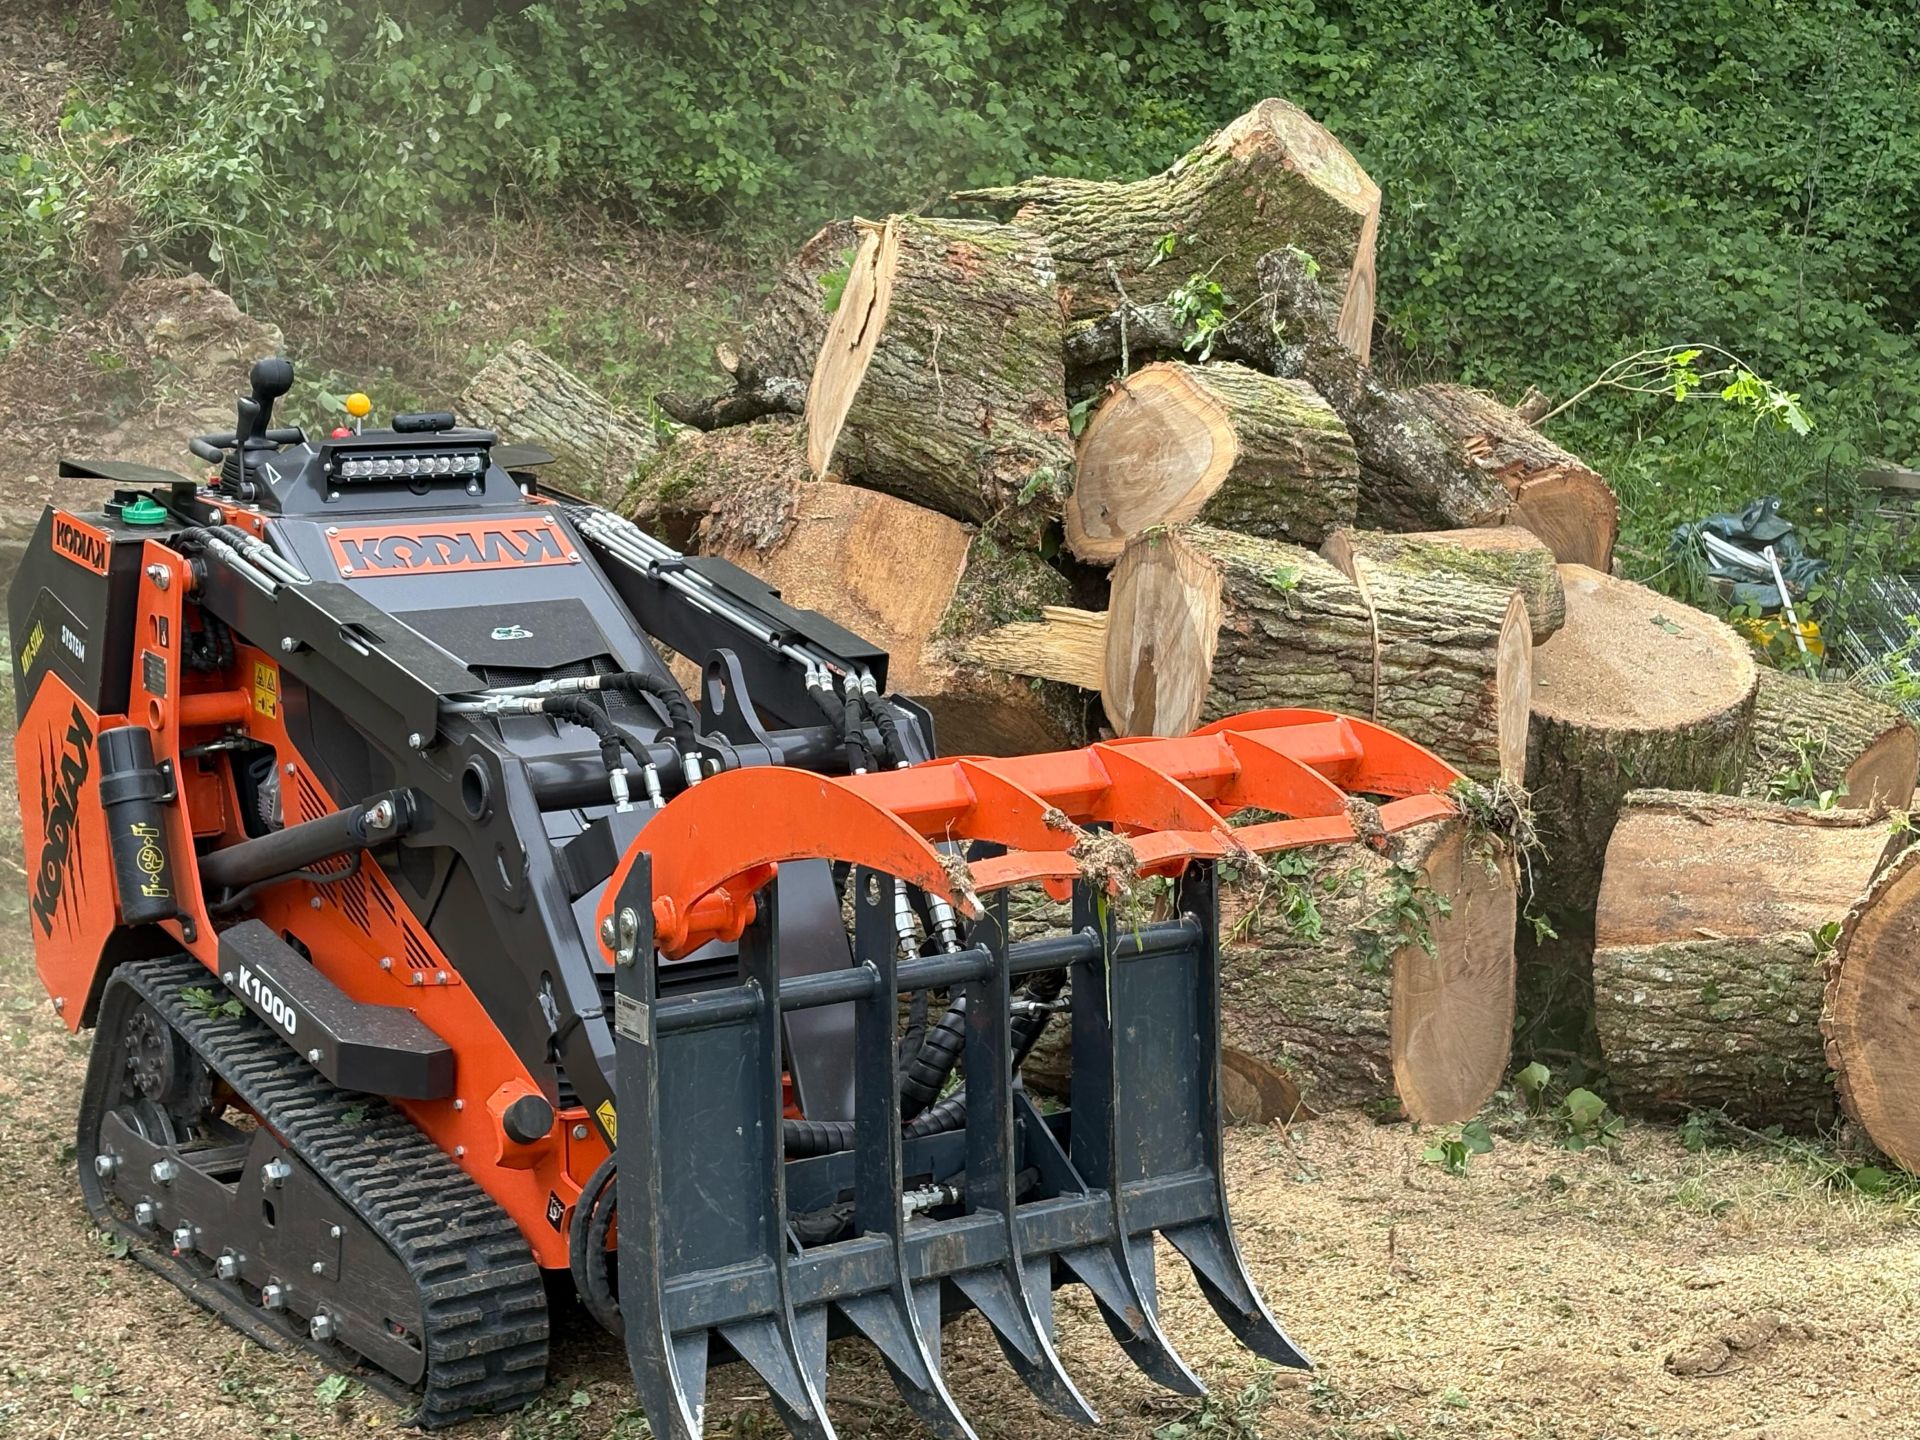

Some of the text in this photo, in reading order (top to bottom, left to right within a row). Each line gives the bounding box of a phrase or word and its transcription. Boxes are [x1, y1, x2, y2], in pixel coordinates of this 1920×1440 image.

[57, 519, 105, 570] KODIAK
[339, 527, 566, 571] KODIAK
[61, 624, 85, 663] SYSTEM
[32, 701, 93, 940] KODIAK
[239, 964, 297, 1035] K1000
